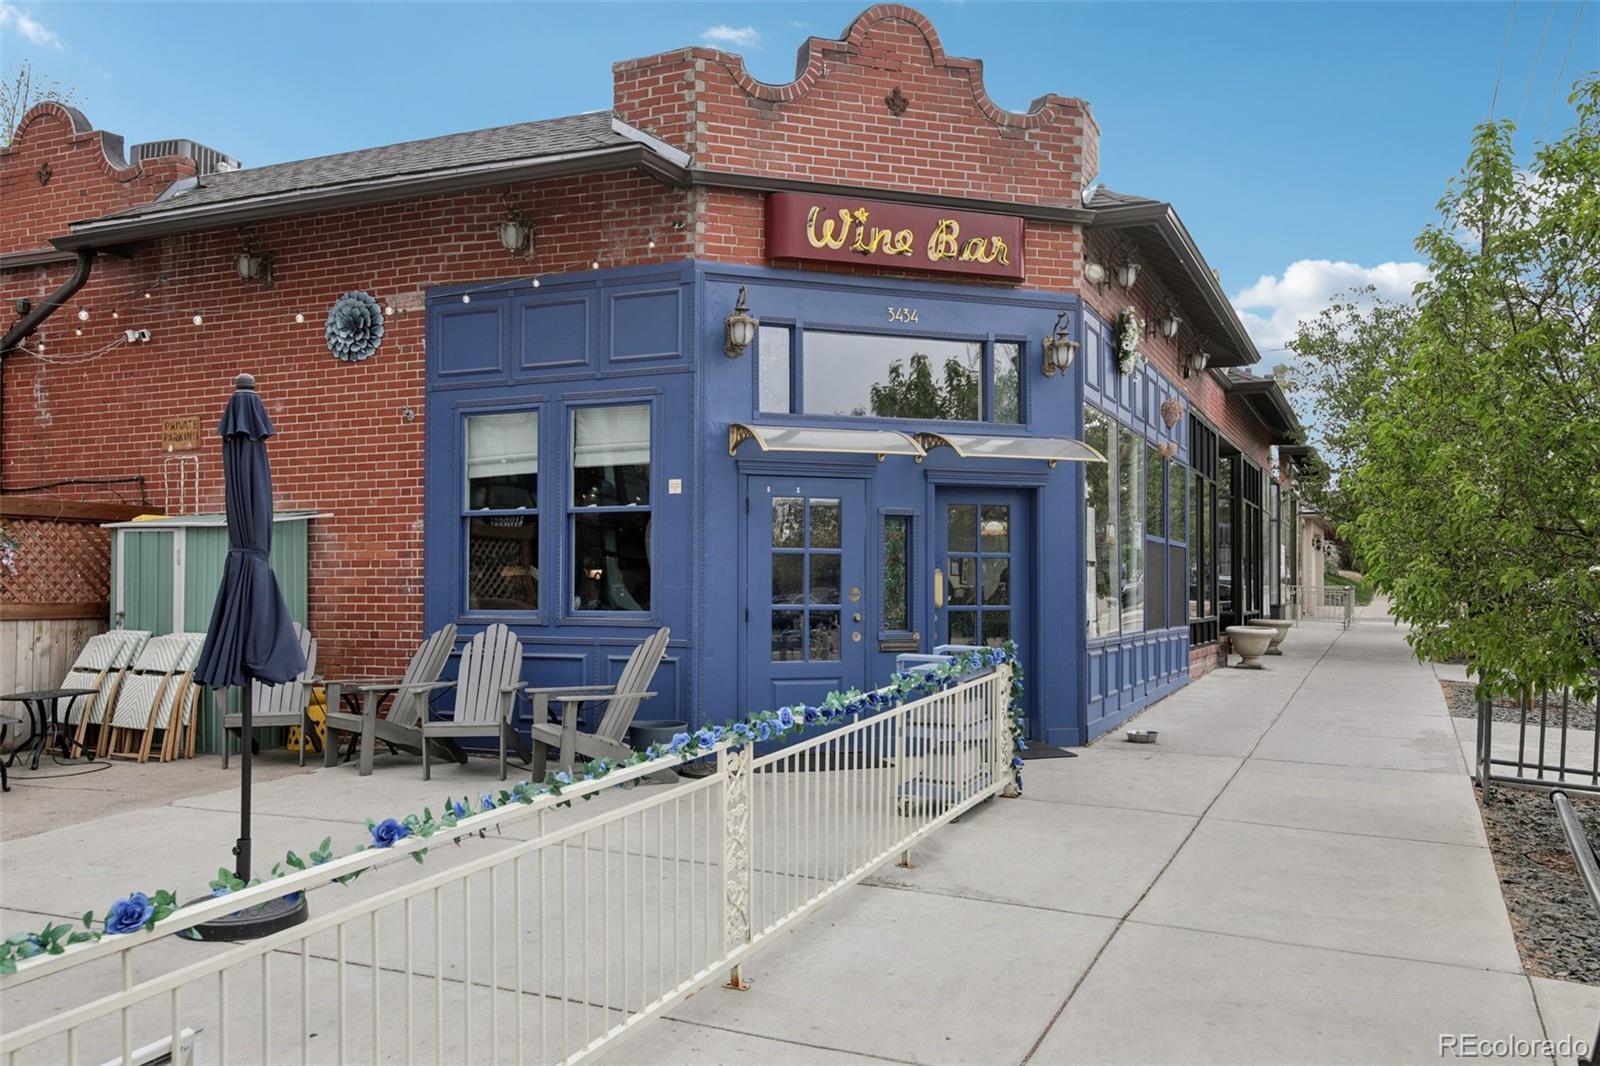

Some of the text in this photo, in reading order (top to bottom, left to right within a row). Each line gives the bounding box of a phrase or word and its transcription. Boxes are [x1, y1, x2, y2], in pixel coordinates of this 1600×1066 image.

[806, 206, 1010, 266] Wine Bar
[887, 306, 919, 324] 3434
[164, 420, 198, 431] PRIVATE
[163, 431, 200, 442] PARKING
